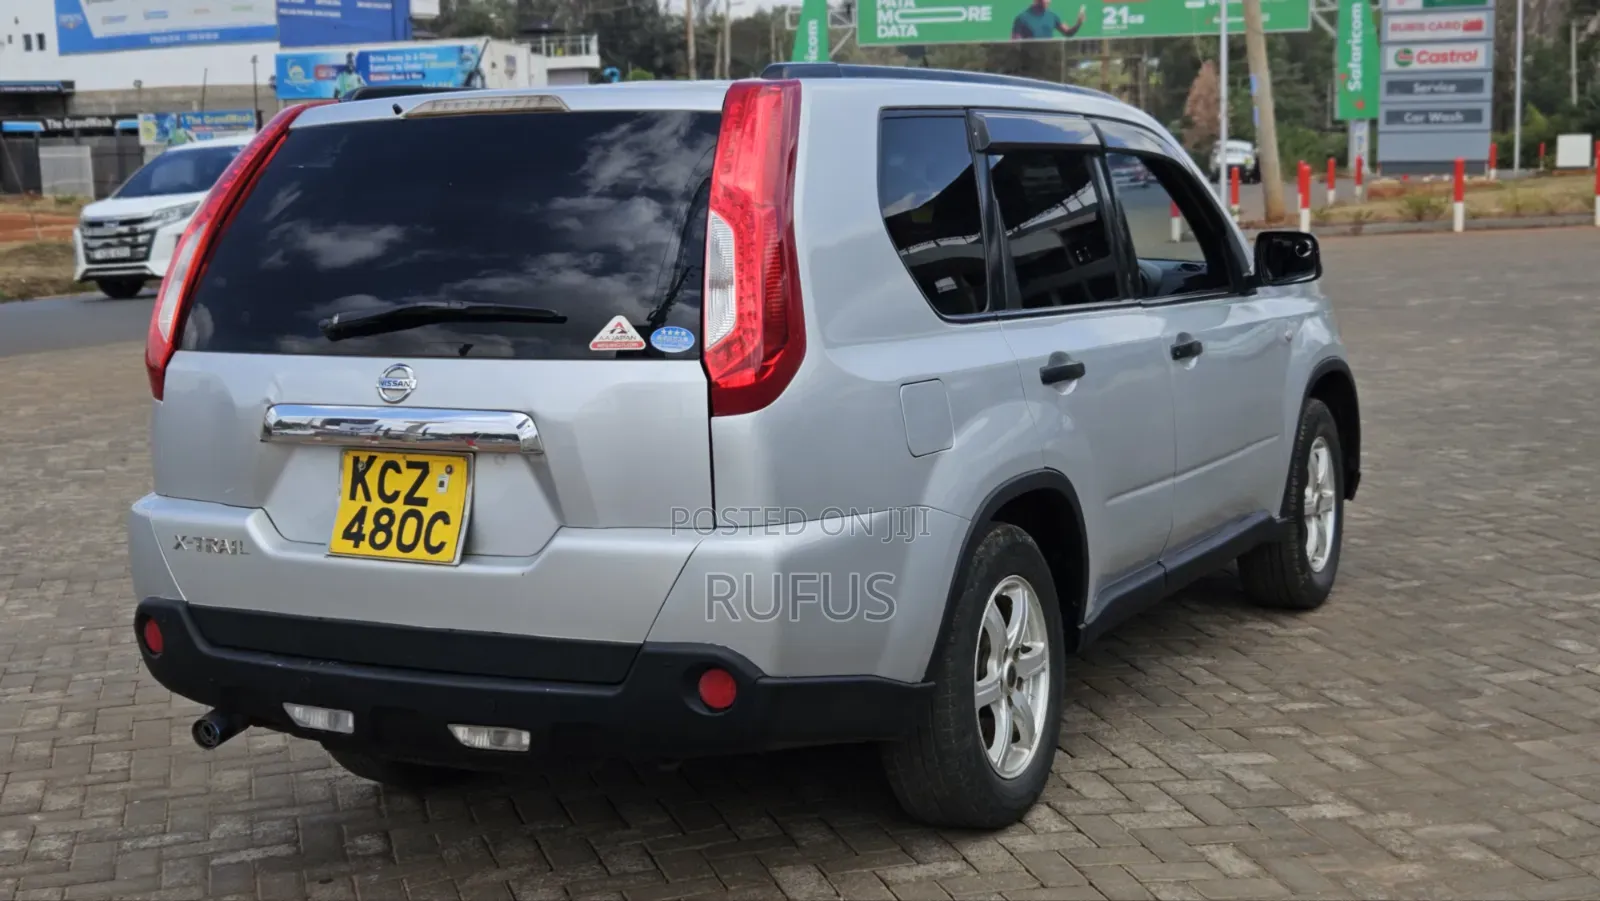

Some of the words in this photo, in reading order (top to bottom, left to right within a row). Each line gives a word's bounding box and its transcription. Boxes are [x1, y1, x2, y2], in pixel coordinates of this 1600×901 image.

[877, 24, 918, 38] DATA
[1347, 2, 1363, 93] Safaricom
[1416, 48, 1478, 64] Castrol
[1413, 82, 1457, 93] Service
[47, 119, 62, 129] The
[186, 115, 201, 124] The
[1404, 112, 1424, 123] Car
[1429, 111, 1464, 123] Wash
[349, 455, 430, 507] KCZ
[341, 505, 451, 555] 480C
[173, 534, 251, 555] X-TRAIL
